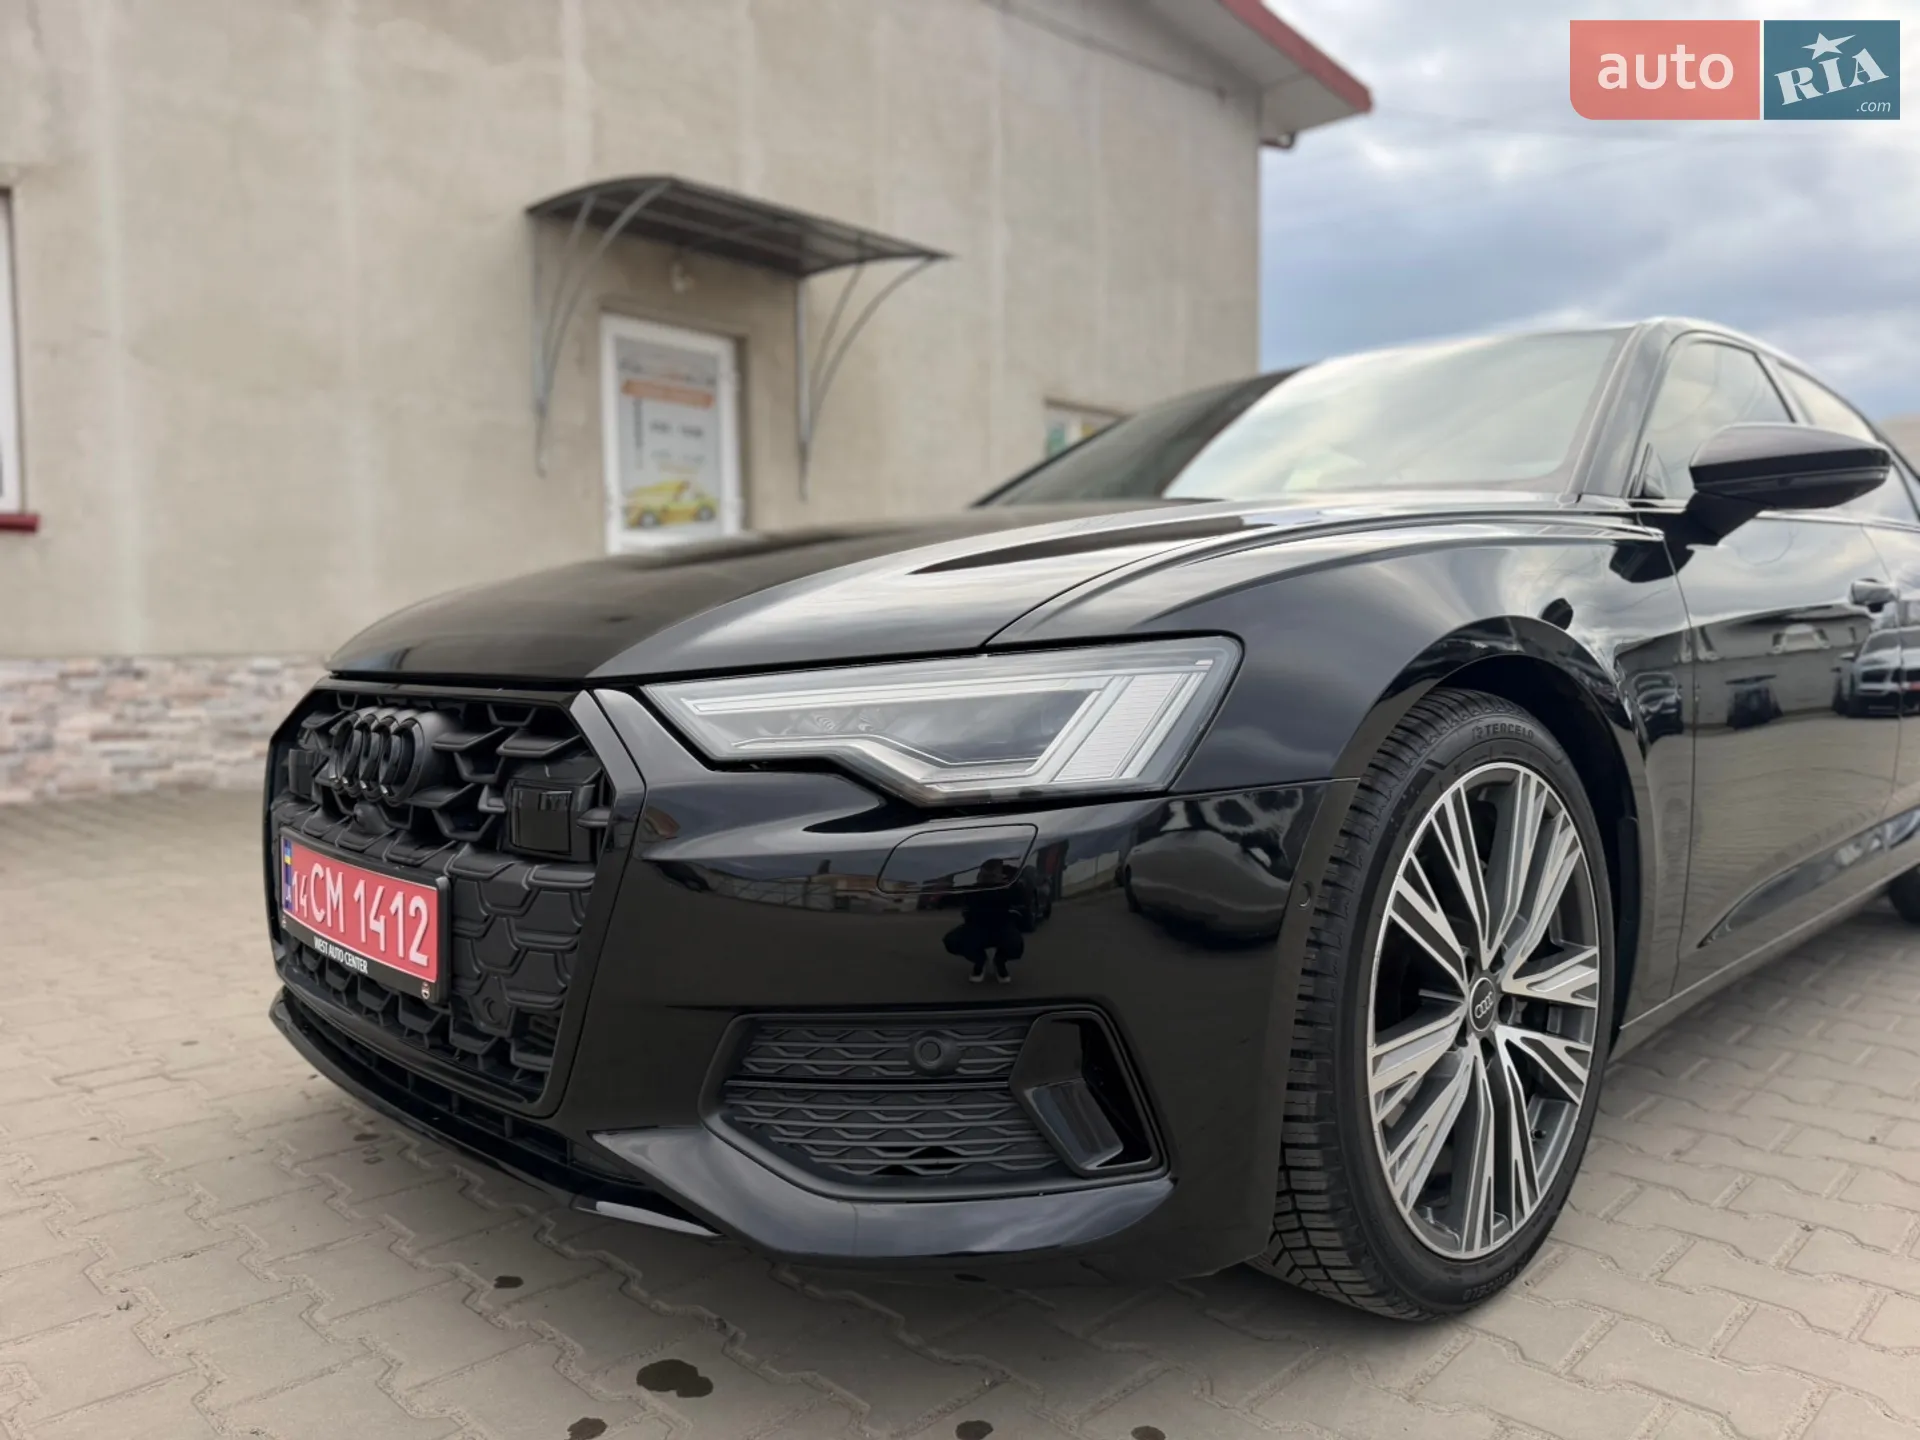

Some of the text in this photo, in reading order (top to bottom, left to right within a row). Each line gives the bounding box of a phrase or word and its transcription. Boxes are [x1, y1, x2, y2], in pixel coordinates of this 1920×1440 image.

[313, 935, 368, 974] WEST AUTO CENTER
[353, 878, 429, 967] 1412
